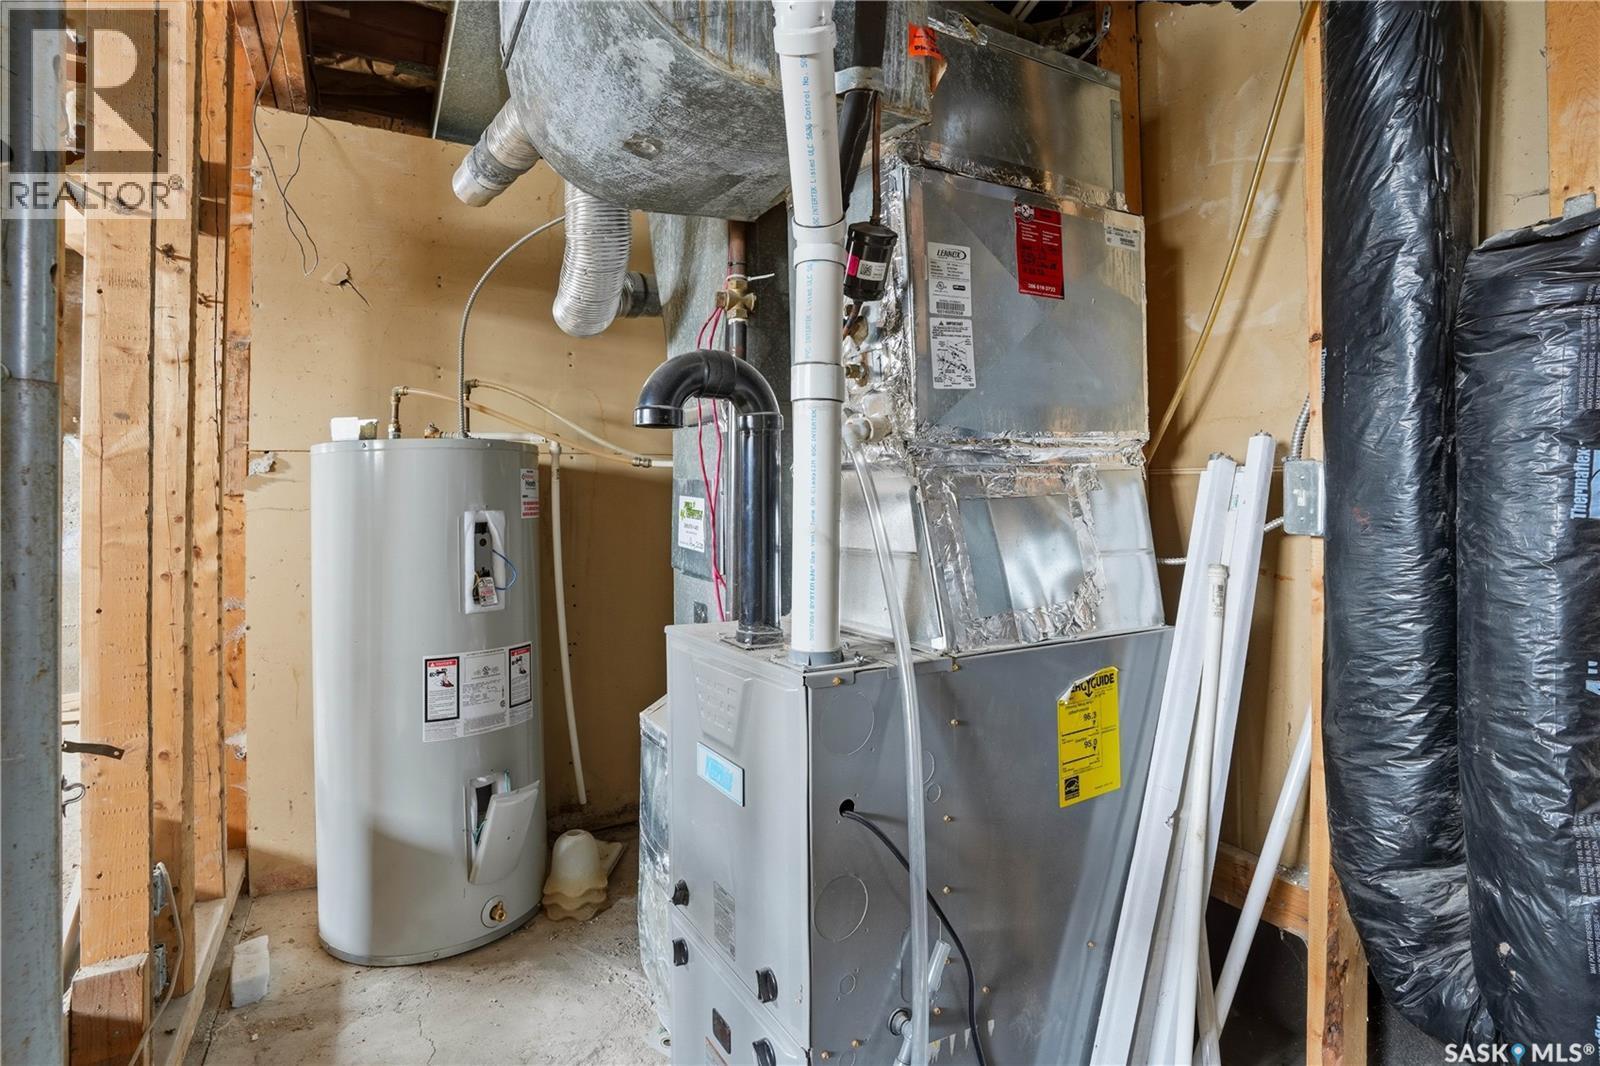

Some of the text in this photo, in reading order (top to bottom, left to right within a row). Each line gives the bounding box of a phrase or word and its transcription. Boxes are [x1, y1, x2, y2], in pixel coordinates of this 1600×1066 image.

[802, 90, 812, 120] Control
[805, 144, 815, 156] ULC
[808, 159, 817, 184] Listed
[809, 186, 819, 215] INTERTEK
[936, 248, 965, 260] LENNOX
[1579, 351, 1587, 377] PRESSURE
[1570, 448, 1591, 519] Thermaflex
[1584, 913, 1593, 940] PRESSURE
